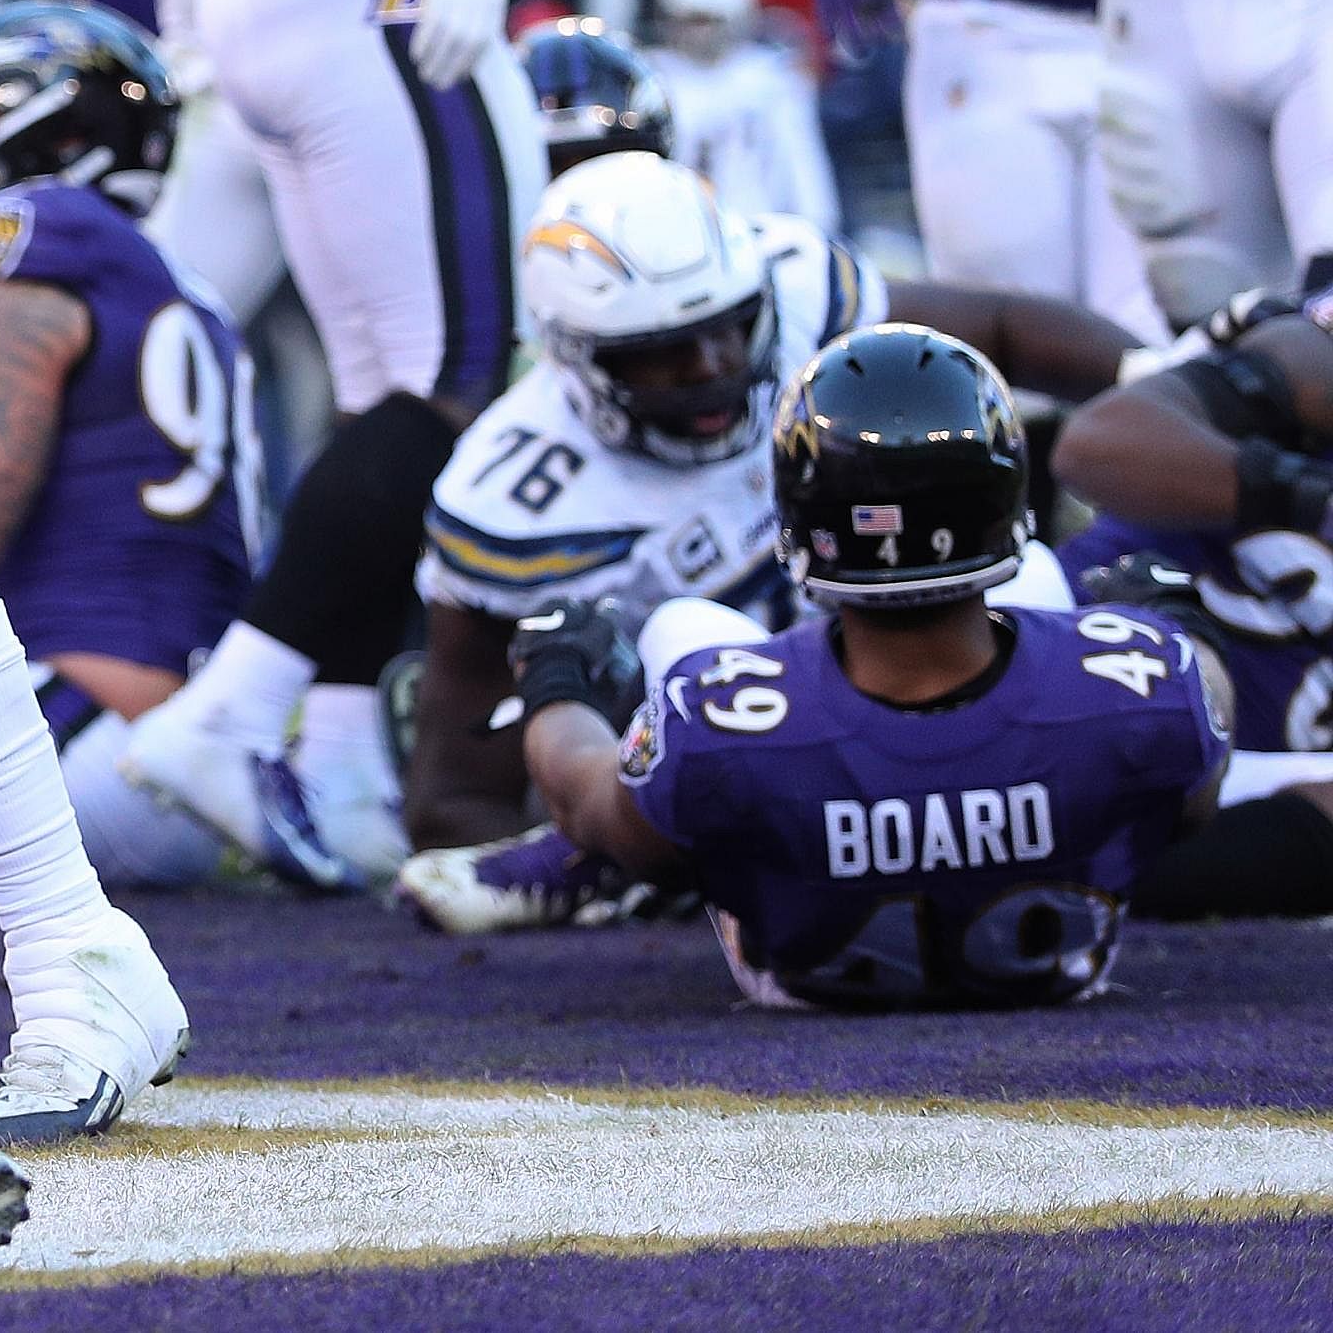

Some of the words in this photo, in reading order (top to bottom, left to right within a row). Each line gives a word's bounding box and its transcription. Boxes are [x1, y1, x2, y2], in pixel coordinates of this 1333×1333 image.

[470, 426, 585, 514] 76
[699, 647, 789, 733] 49
[1079, 610, 1167, 699] 49
[823, 782, 1055, 879] BOARD
